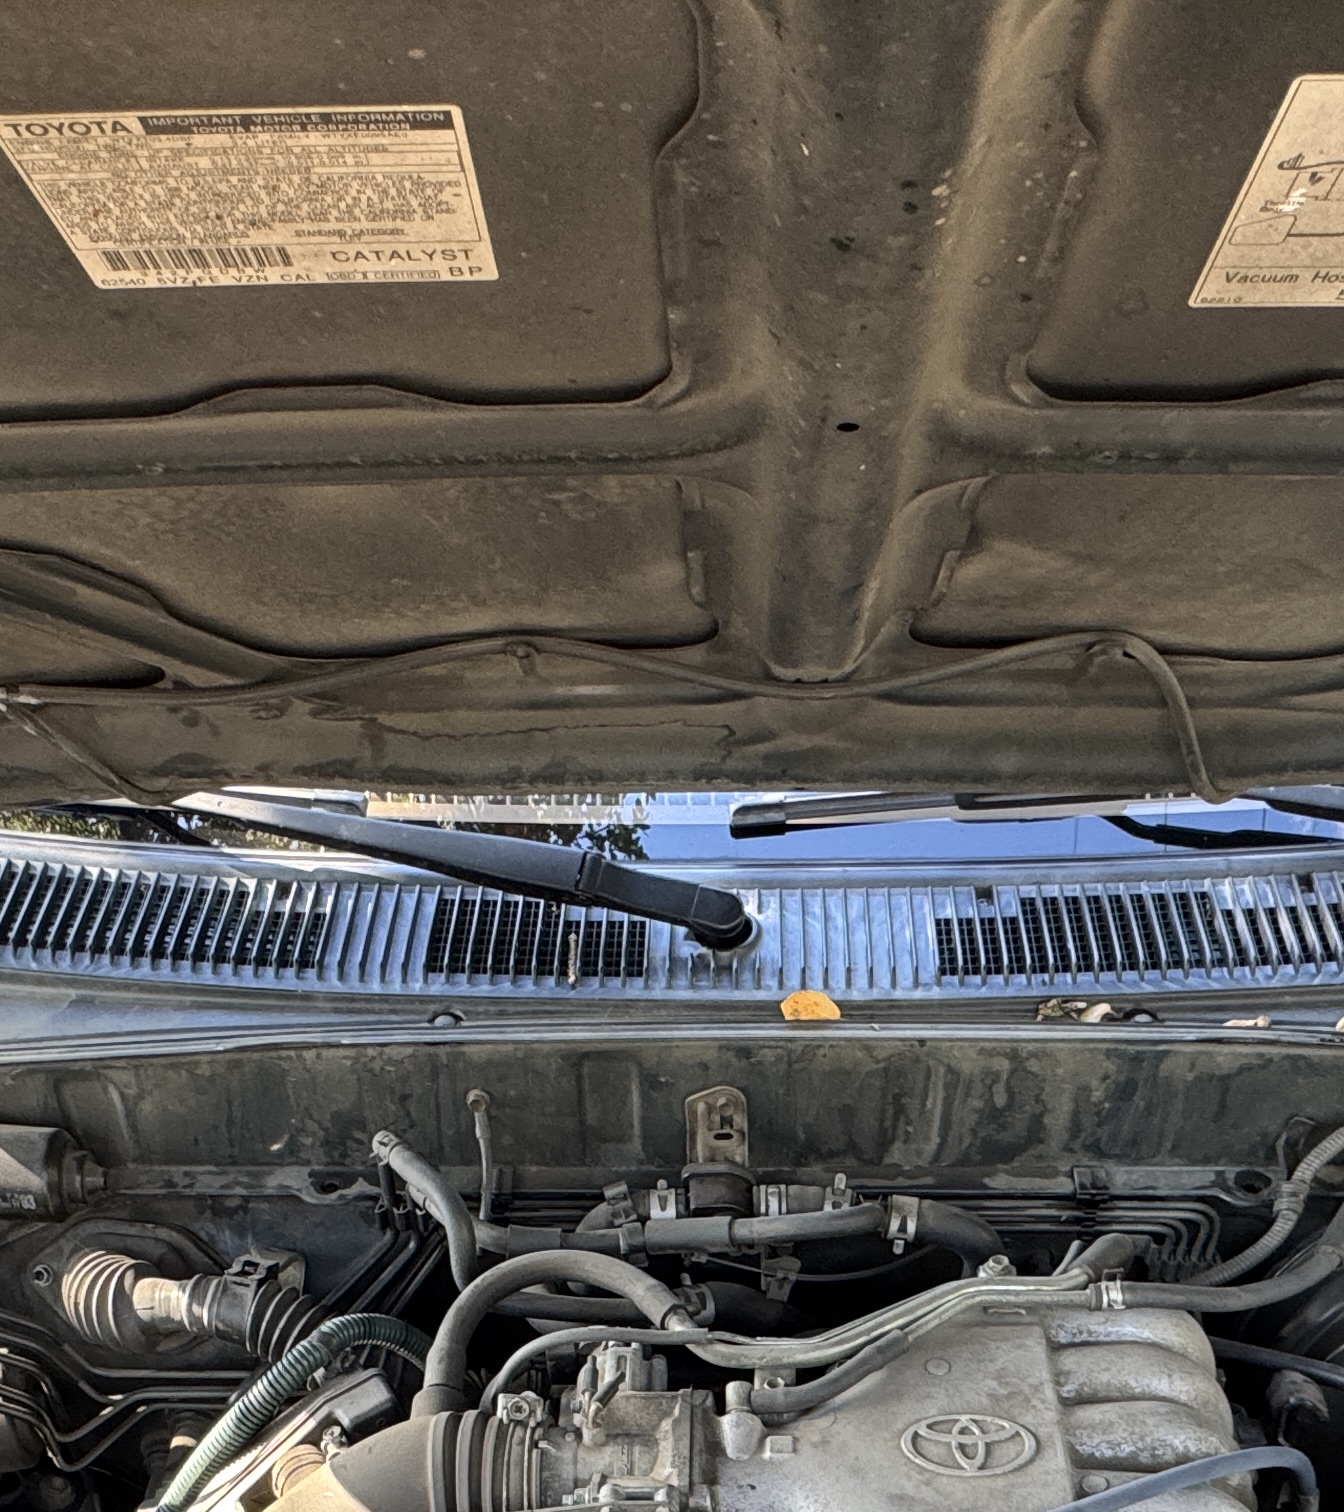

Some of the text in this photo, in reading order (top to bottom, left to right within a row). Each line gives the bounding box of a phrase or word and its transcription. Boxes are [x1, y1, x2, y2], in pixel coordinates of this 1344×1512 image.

[147, 111, 446, 127] IMPORTANT VEHICLE INFORMATION
[6, 120, 133, 138] TOYOTA
[191, 126, 246, 134] TOYOTA
[307, 122, 411, 132] CORPORATION
[330, 248, 476, 263] CATALYST
[232, 274, 269, 283] VZN
[280, 273, 317, 282] CAL
[449, 266, 483, 278] BP
[1223, 271, 1300, 284] Vacuum
